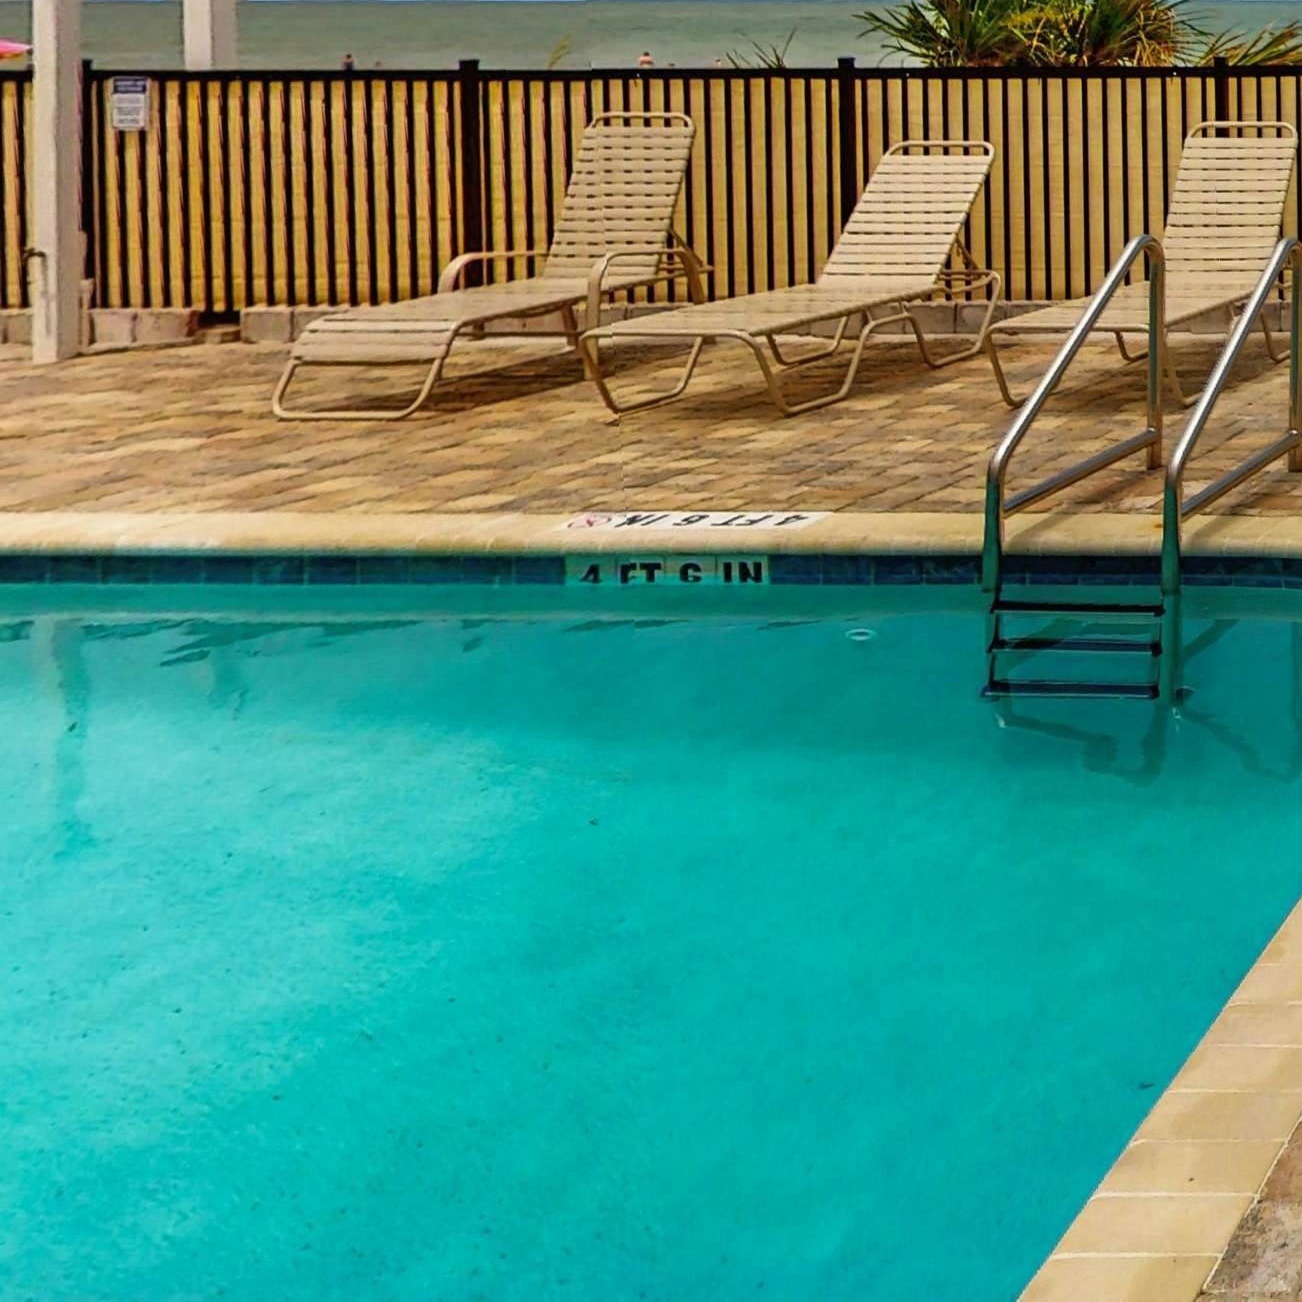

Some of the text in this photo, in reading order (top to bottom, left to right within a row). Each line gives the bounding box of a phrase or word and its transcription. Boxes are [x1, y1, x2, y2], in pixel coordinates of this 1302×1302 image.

[711, 514, 773, 527] FT
[579, 563, 603, 584] 4
[723, 561, 763, 584] IN
